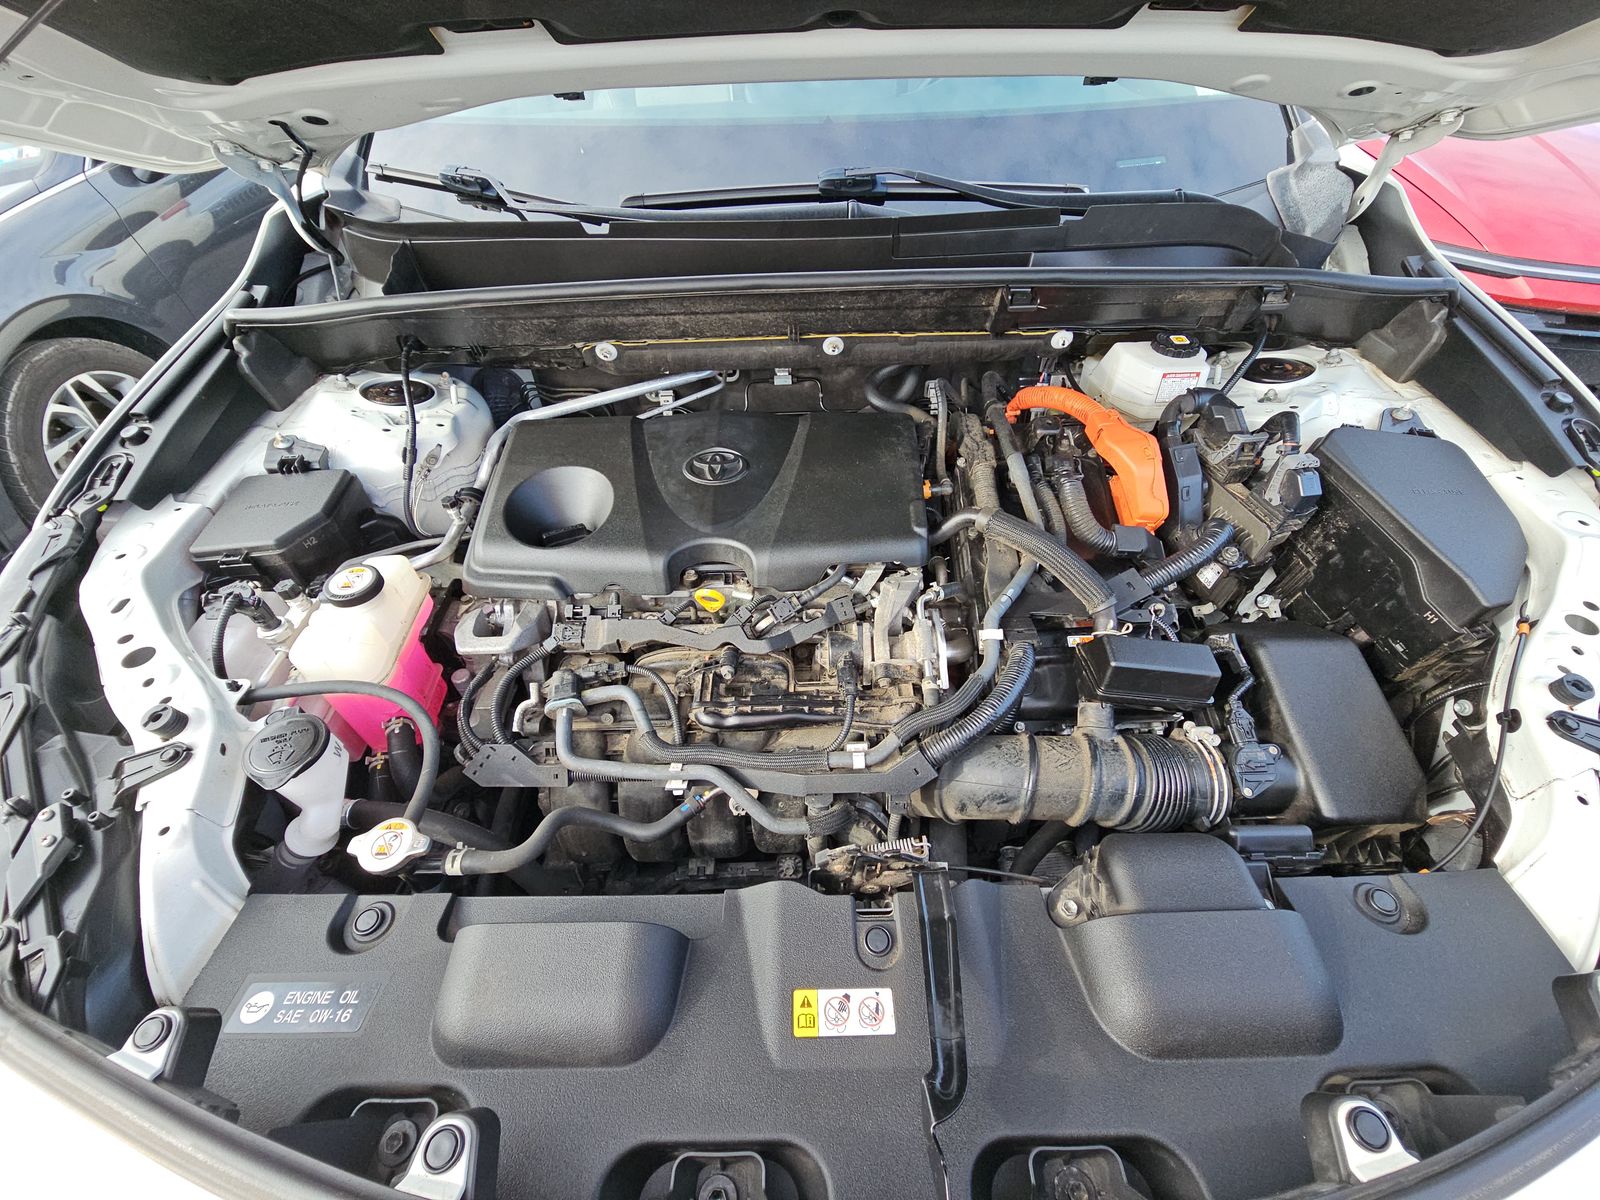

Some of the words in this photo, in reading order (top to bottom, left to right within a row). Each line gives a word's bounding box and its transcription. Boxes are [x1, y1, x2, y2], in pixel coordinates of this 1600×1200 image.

[302, 536, 319, 549] H2
[1423, 610, 1439, 624] H1
[283, 990, 335, 1005] ENGINE
[339, 989, 360, 1004] OIL
[273, 1009, 304, 1023] SAE
[309, 1008, 353, 1023] 0W-16
